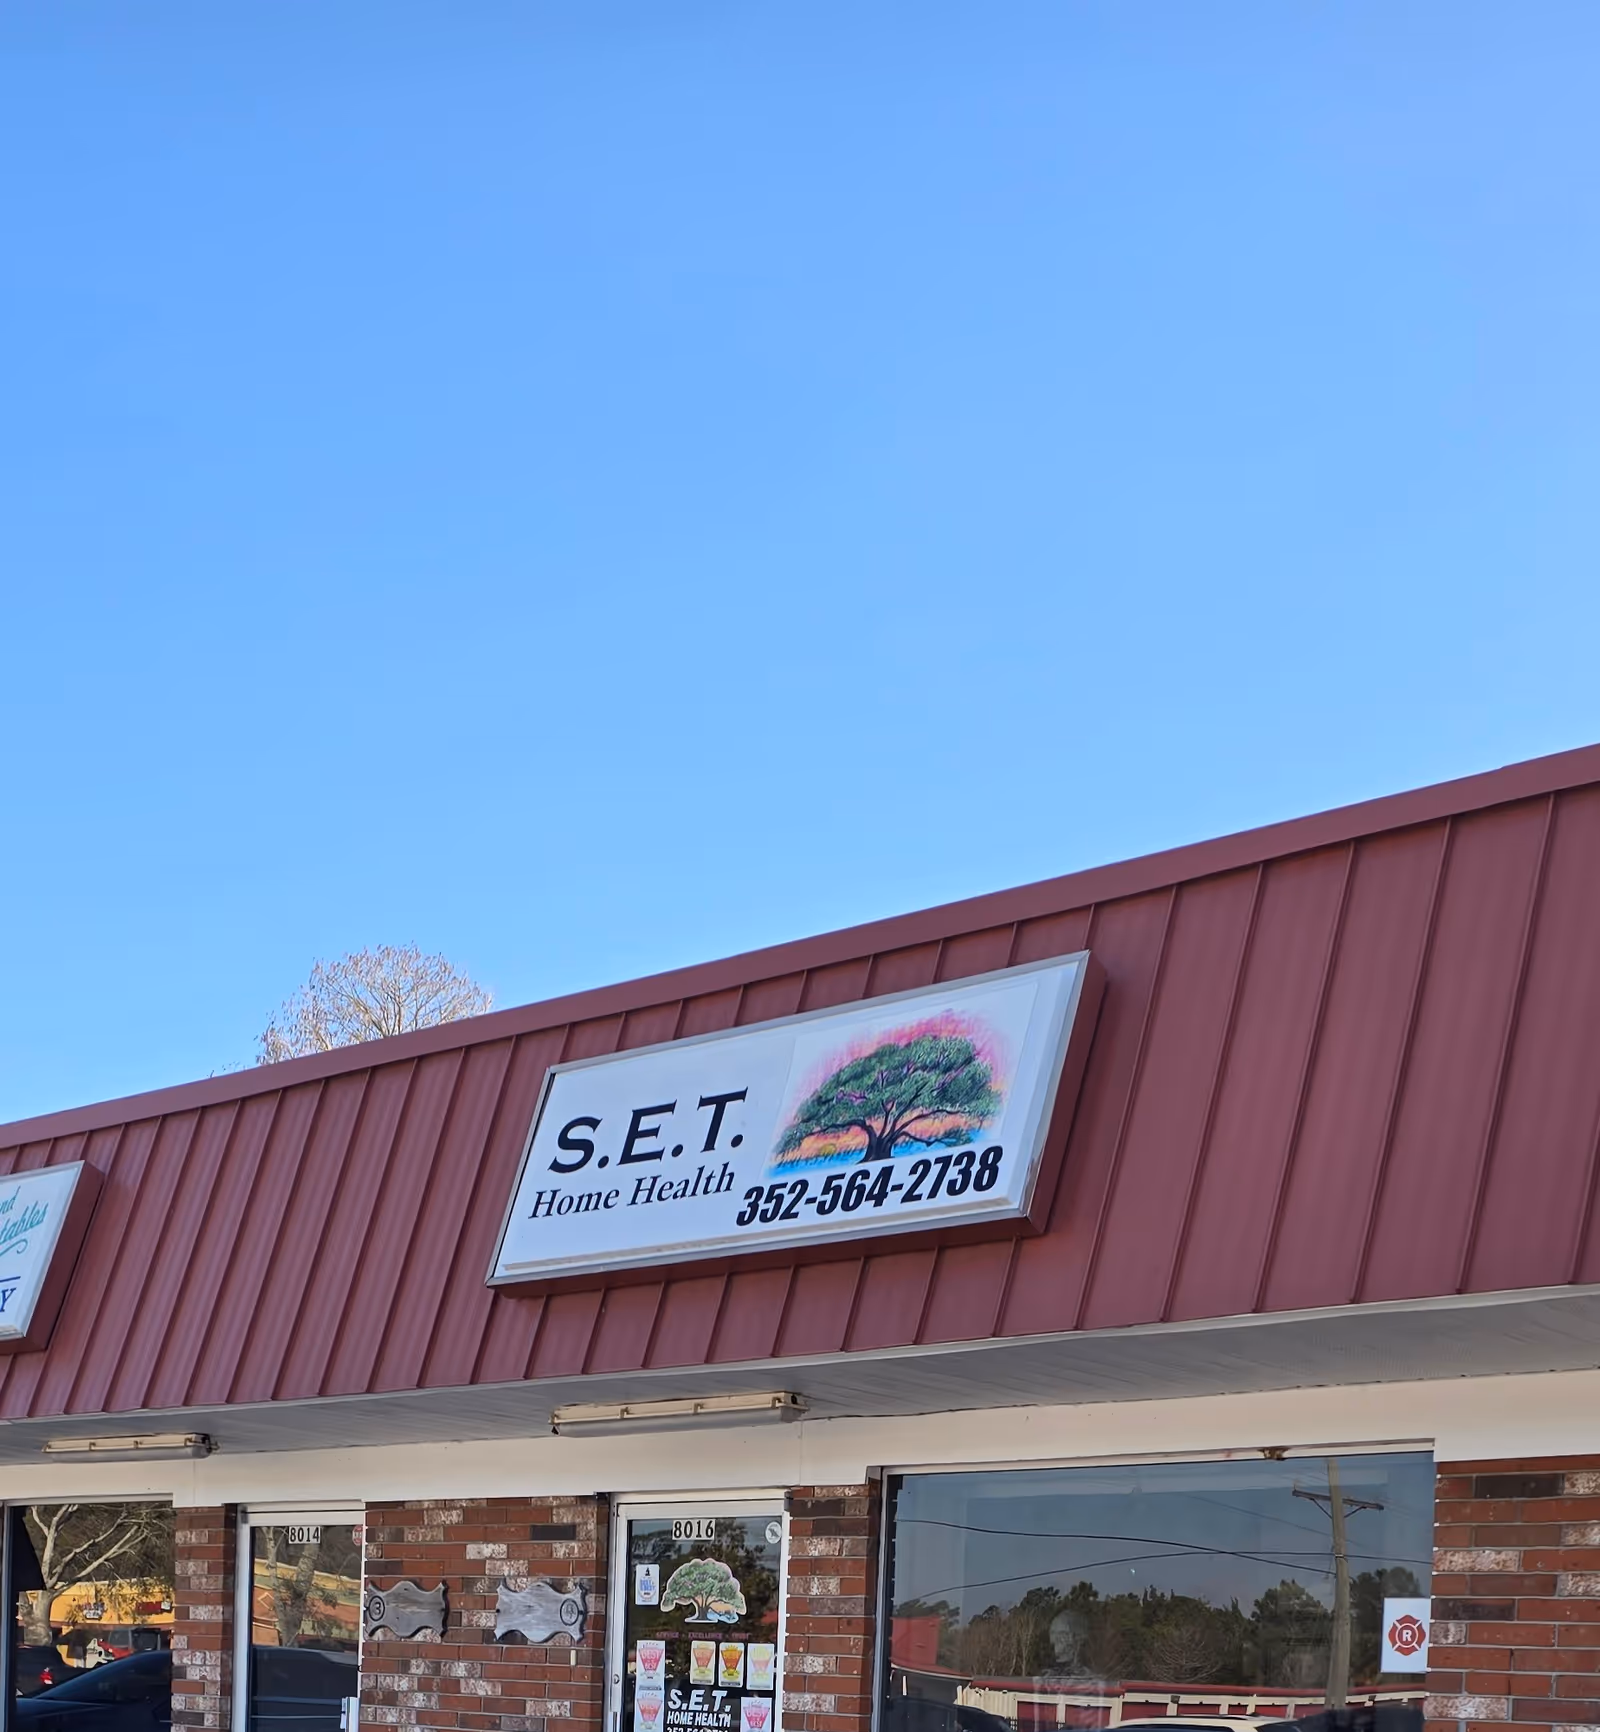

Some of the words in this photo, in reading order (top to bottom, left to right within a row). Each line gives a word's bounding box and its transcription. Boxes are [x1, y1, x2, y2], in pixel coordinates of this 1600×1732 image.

[547, 1088, 747, 1174] S.E.T.
[528, 1190, 620, 1219] Home
[627, 1161, 735, 1206] Health
[735, 1145, 1004, 1227] 352-564-2738
[0, 1200, 49, 1245] tables
[290, 1527, 320, 1543] 8014
[673, 1520, 714, 1539] 8016
[1402, 1629, 1413, 1642] R
[667, 1688, 731, 1712] S.E.T.
[666, 1711, 693, 1725] HOME
[694, 1712, 731, 1727] HEALTH
